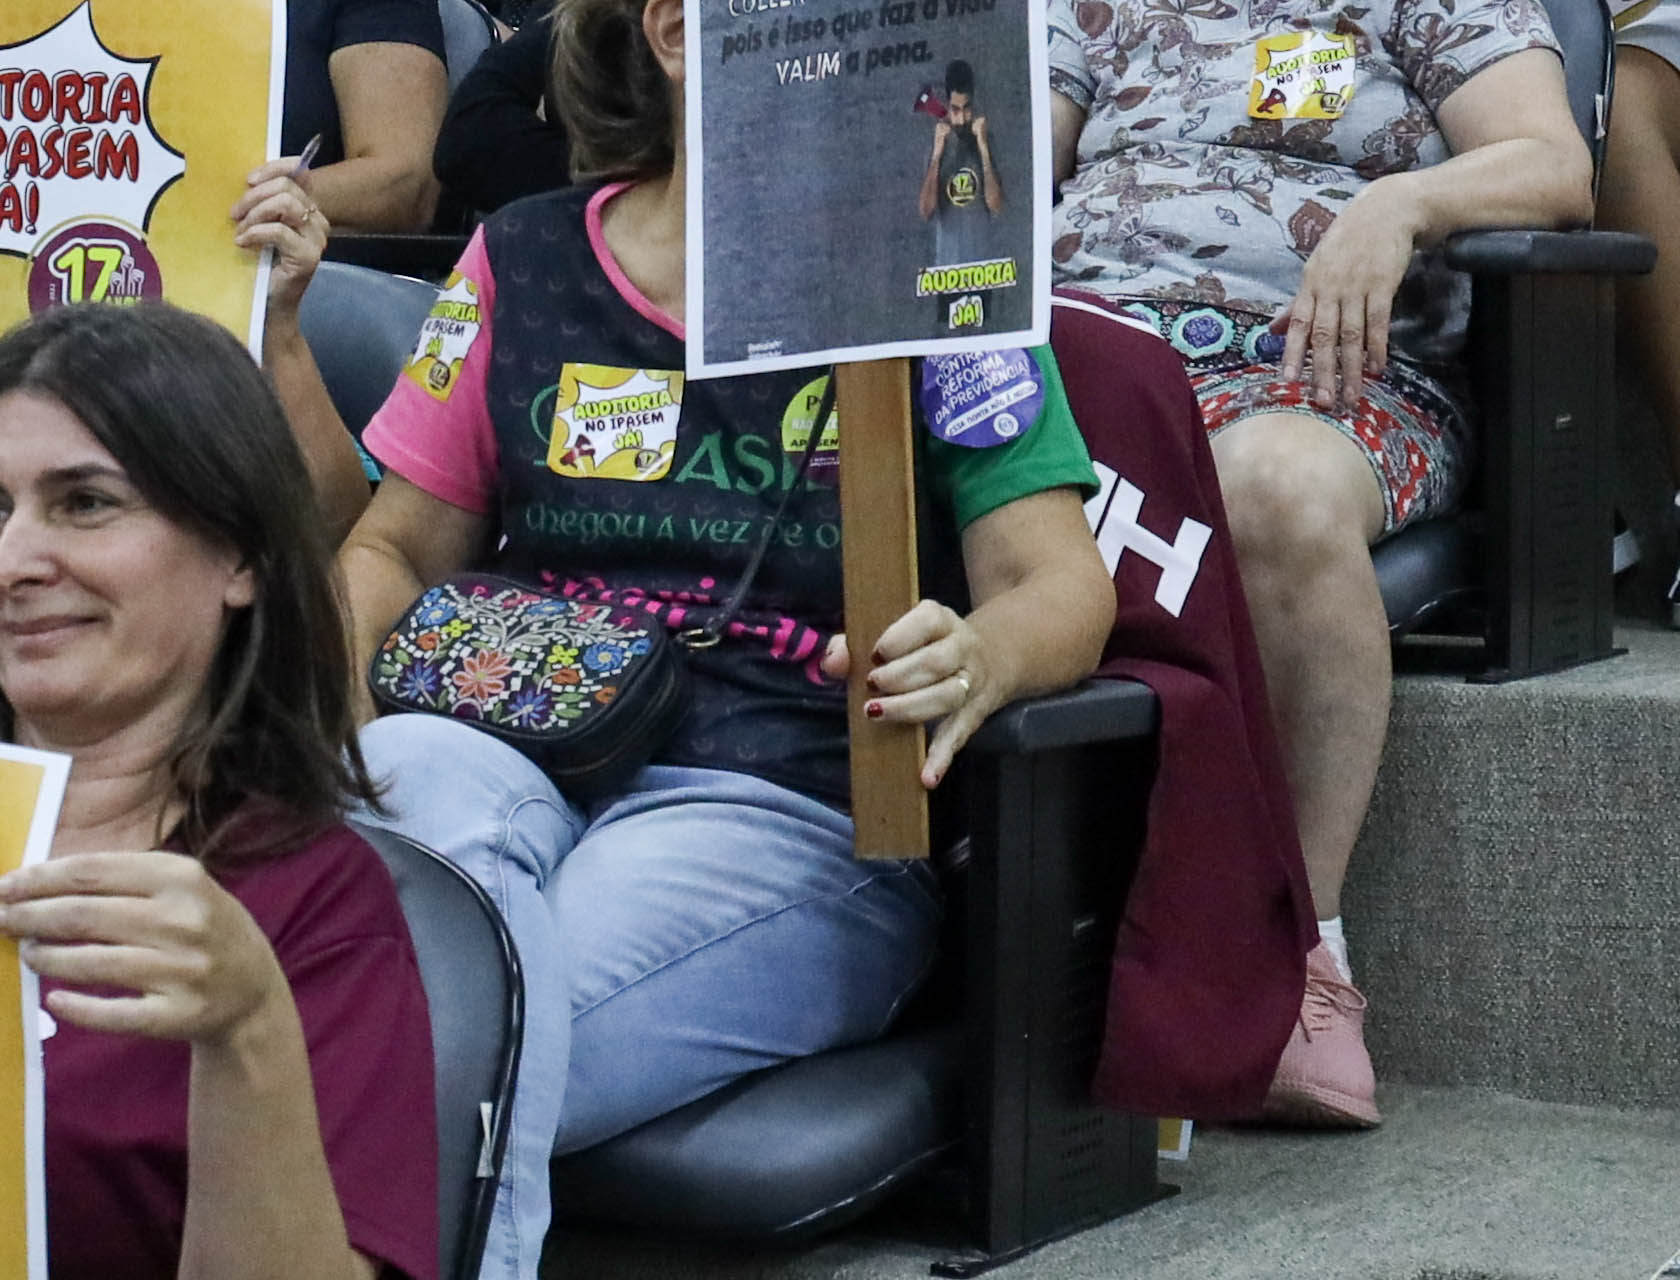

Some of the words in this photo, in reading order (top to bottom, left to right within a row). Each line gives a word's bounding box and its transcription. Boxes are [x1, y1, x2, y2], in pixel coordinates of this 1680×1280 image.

[722, 24, 761, 64] pois
[785, 17, 825, 45] isso
[831, 10, 873, 41] que
[879, 0, 916, 26] faz
[922, 0, 938, 20] a
[776, 51, 840, 85] VALIM
[846, 50, 860, 71] a
[1277, 74, 1293, 85] NO
[920, 261, 1016, 292] AUDITORIA
[952, 295, 983, 327] JÁ!
[942, 353, 1006, 401] REFORMA
[574, 389, 673, 421] AUDITORIA
[935, 405, 951, 425] DA
[585, 420, 606, 433] NO
[611, 411, 664, 430] IPASEM
[614, 427, 644, 448] JÁ!
